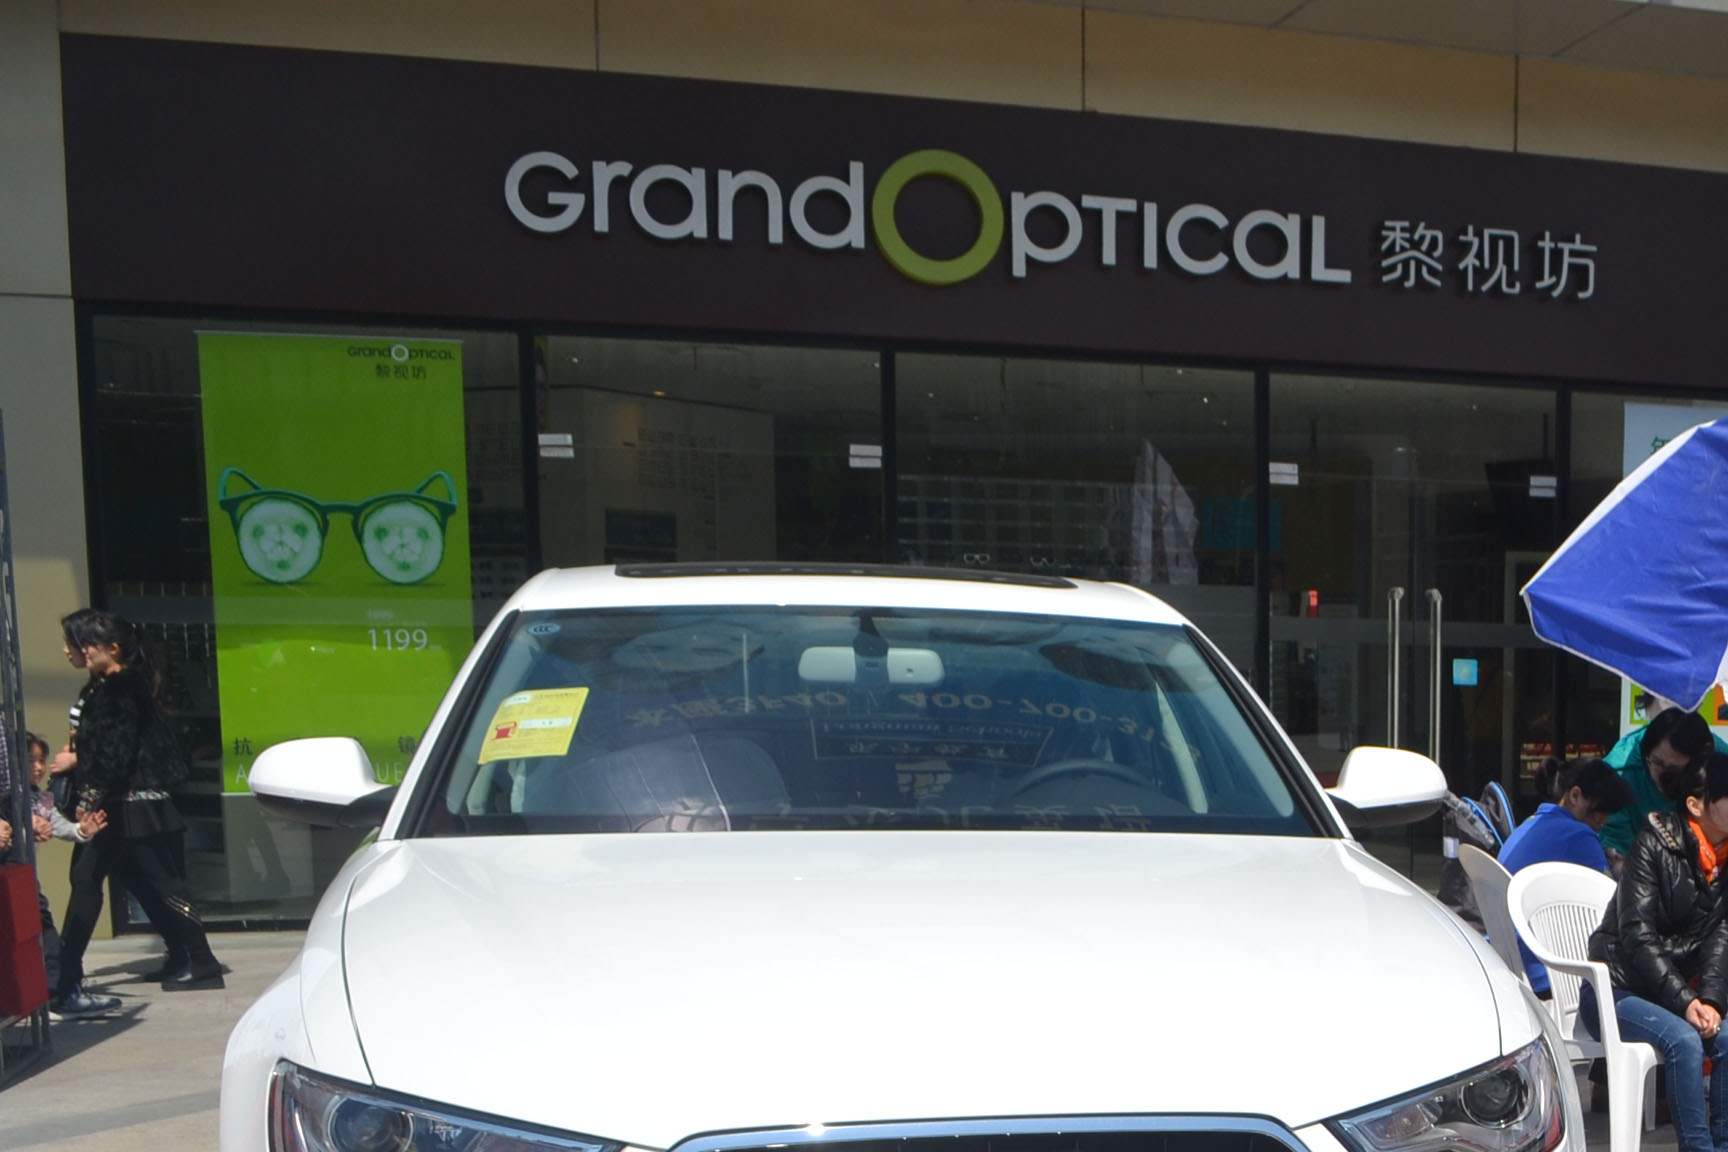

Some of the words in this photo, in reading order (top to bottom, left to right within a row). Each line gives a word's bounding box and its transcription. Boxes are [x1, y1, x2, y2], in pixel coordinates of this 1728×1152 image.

[1380, 218, 1599, 300] 黎视坊
[367, 628, 429, 652] 1199
